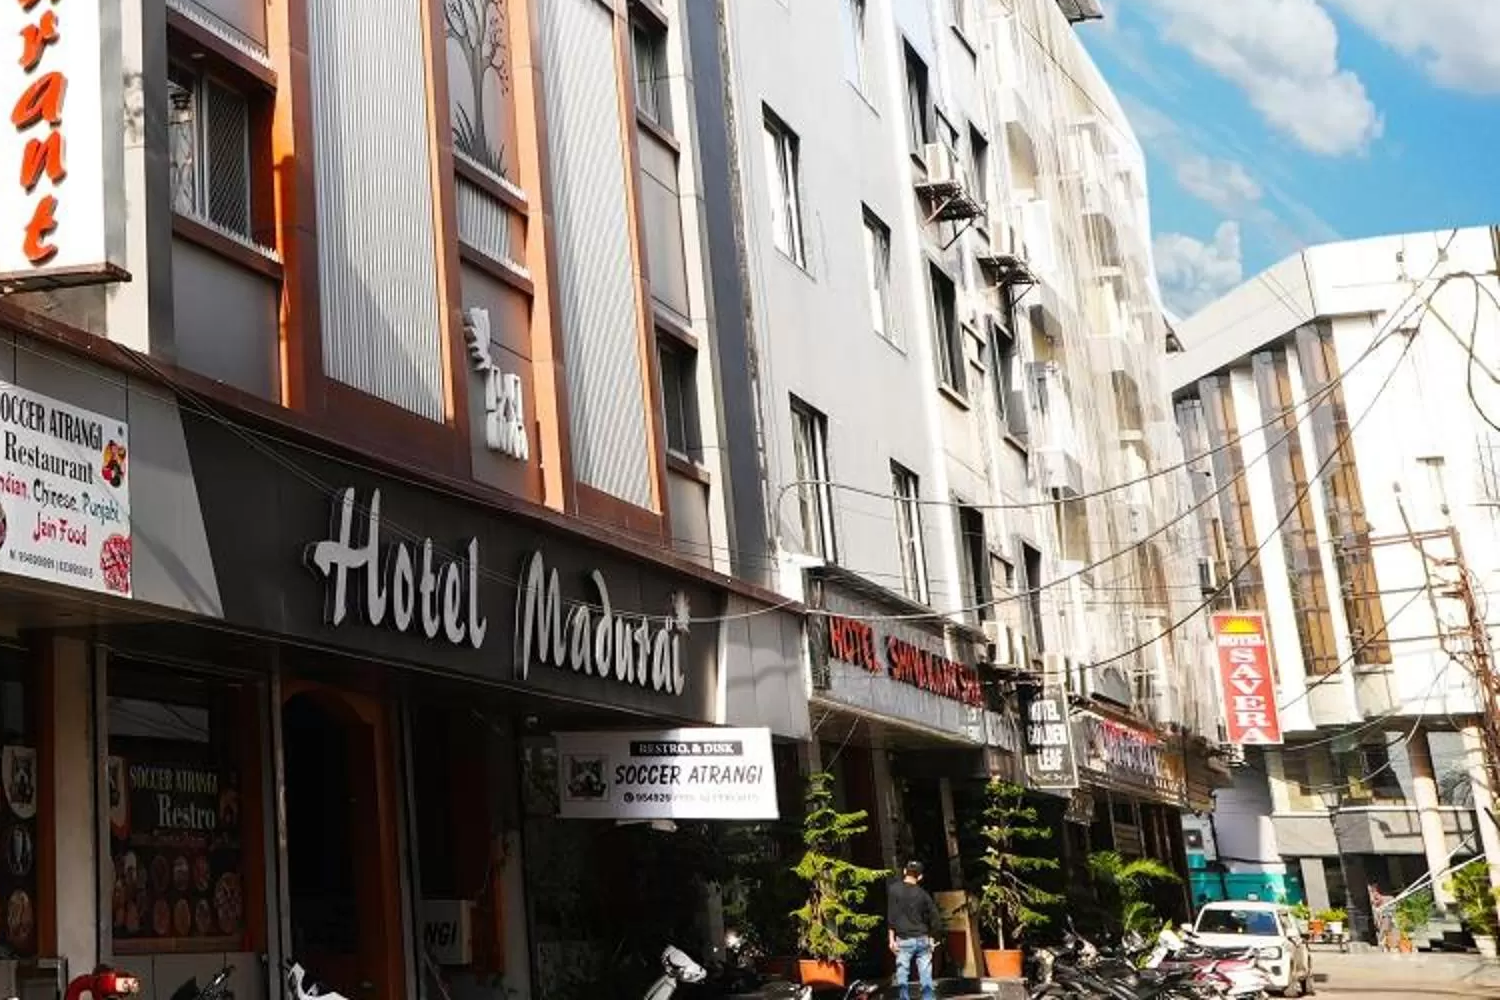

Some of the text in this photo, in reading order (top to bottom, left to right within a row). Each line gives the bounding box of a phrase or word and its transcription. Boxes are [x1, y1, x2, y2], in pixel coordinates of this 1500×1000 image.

[50, 408, 103, 452] ATRANGI
[4, 430, 93, 484] Restaurant
[58, 518, 87, 547] Food
[314, 487, 687, 696] Hotel Madurai
[829, 616, 882, 676] HOTEL
[1228, 649, 1272, 743] SAVERA
[129, 764, 173, 791] SOCCER
[614, 764, 764, 785] SOCCER ATRANGI
[158, 794, 216, 829] Restro
